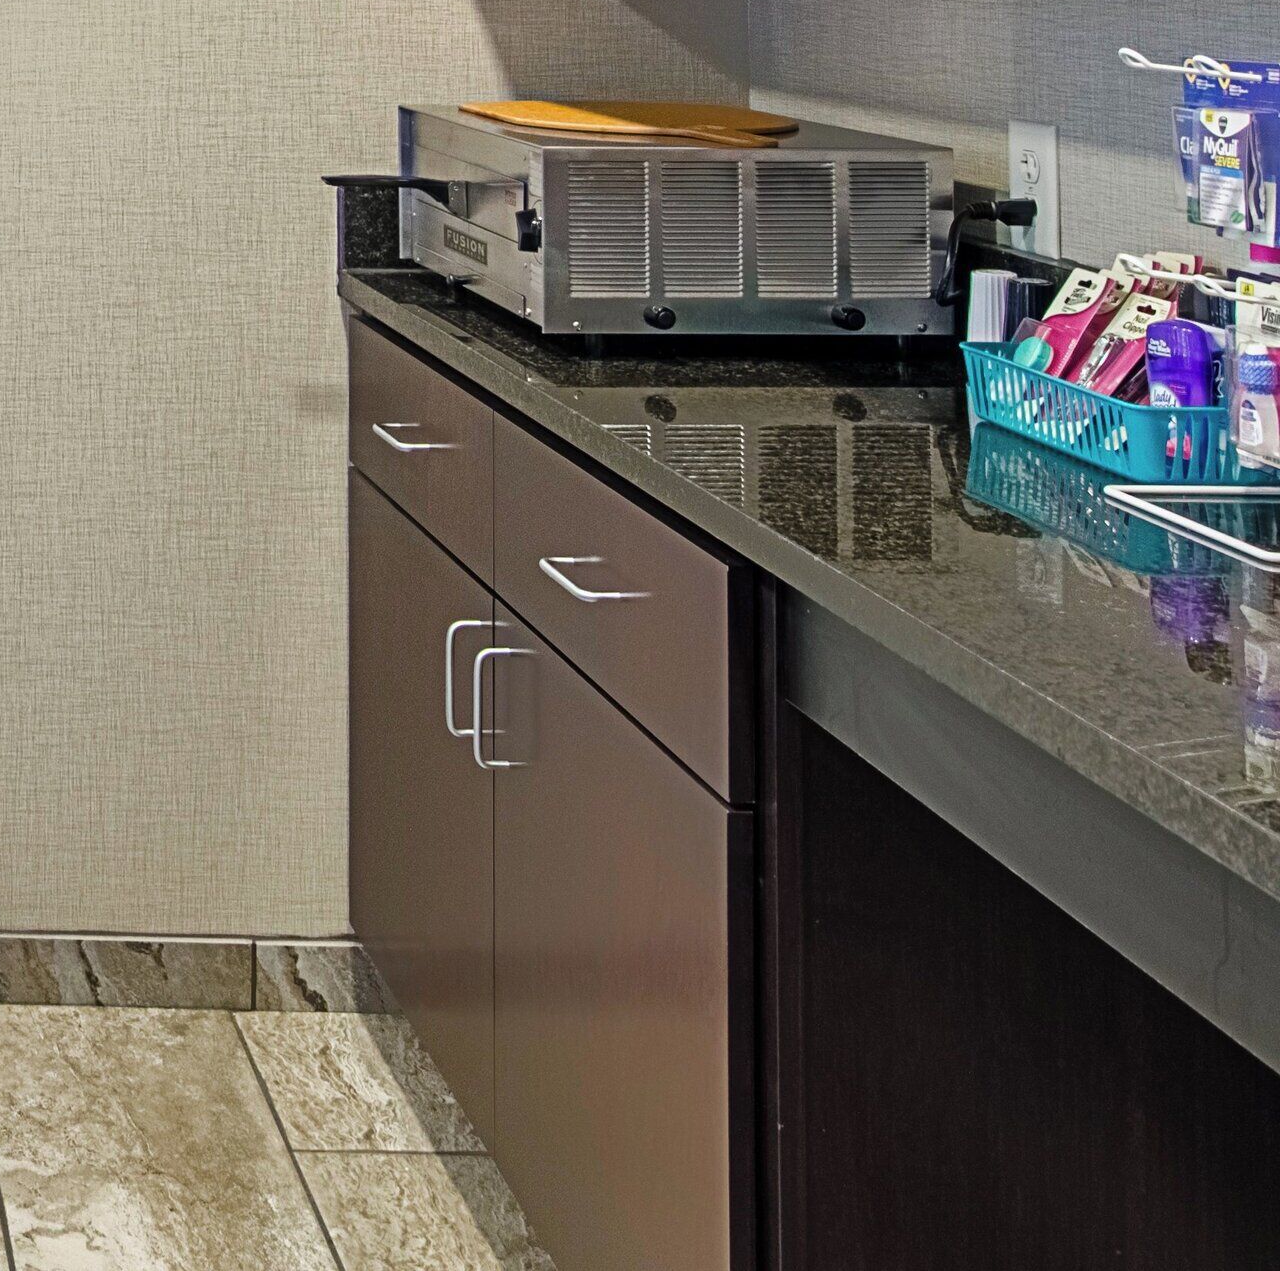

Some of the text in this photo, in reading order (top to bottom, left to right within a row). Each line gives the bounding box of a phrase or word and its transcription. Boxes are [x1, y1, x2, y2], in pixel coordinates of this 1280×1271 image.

[1202, 135, 1240, 161] NyQuil
[1213, 156, 1242, 170] SEVERE
[445, 227, 485, 257] FUSION
